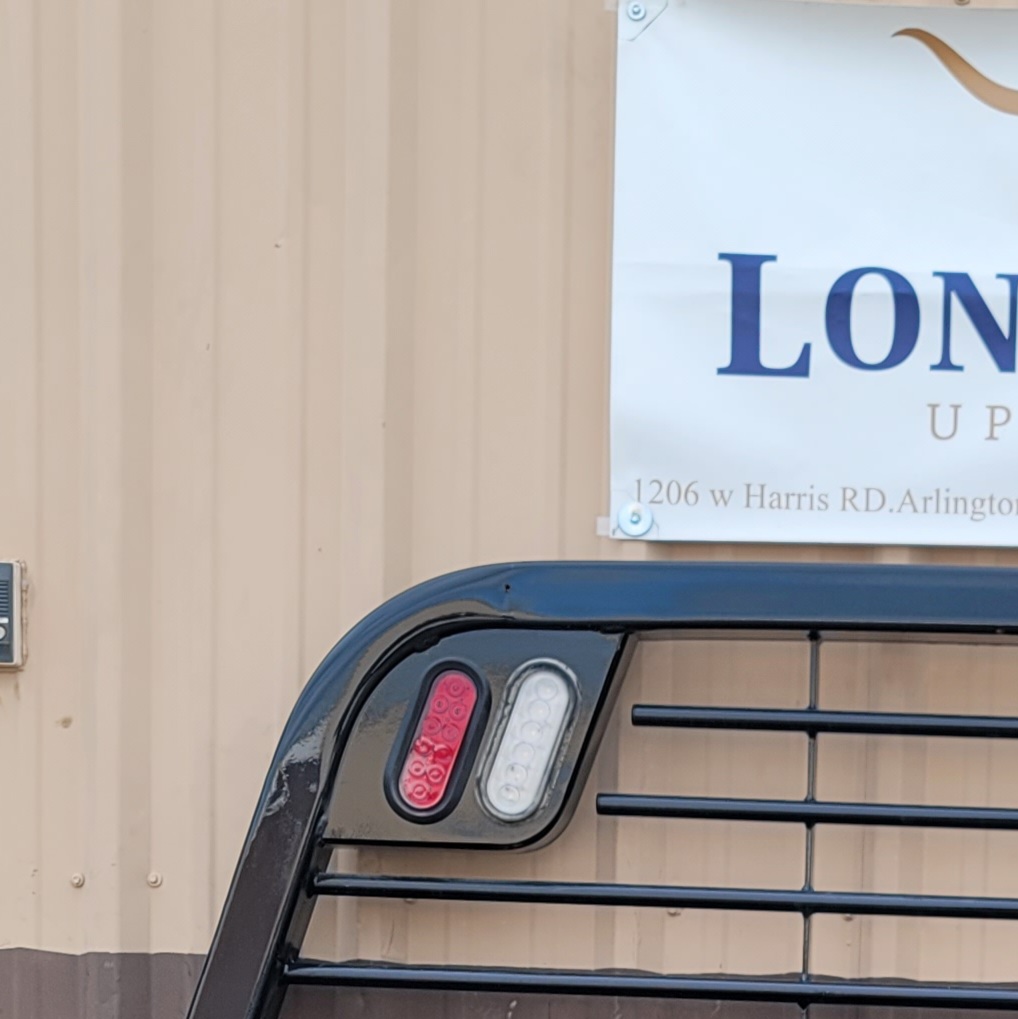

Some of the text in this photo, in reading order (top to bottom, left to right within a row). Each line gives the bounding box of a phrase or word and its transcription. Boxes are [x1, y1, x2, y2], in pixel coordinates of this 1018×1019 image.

[634, 478, 700, 507] 1206
[708, 487, 735, 508] w
[743, 483, 830, 512] Harris
